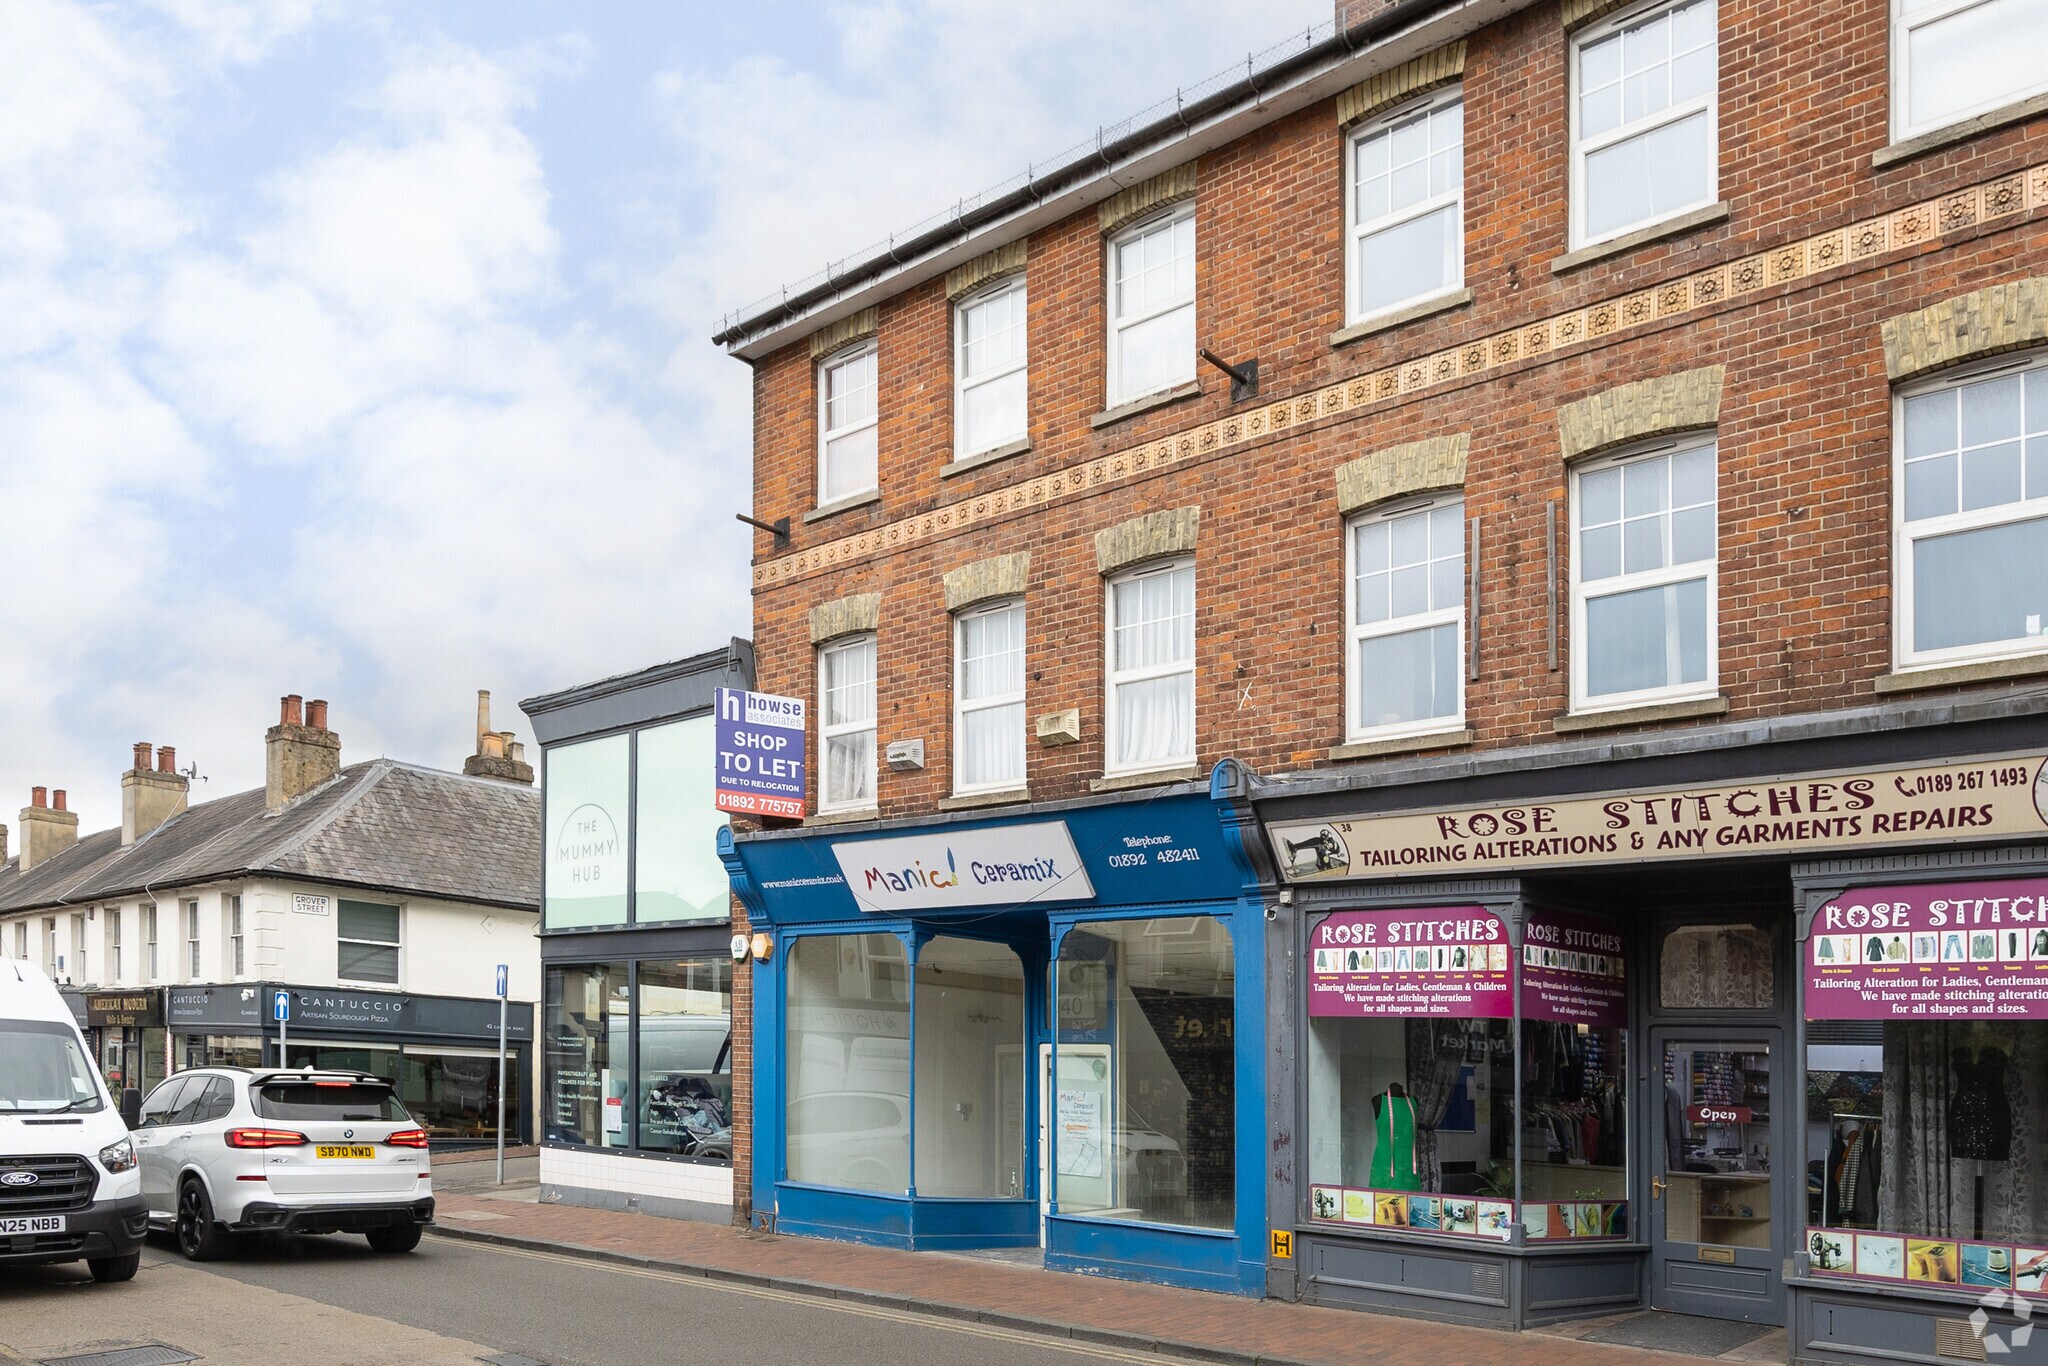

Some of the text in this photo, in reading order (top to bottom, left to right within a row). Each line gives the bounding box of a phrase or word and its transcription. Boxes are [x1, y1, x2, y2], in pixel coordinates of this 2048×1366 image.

[748, 694, 801, 716] howse
[748, 712, 802, 727] associates
[734, 731, 787, 751] SHOP
[720, 752, 800, 778] TO LET
[722, 776, 799, 792] DUE TO RELOCATION
[1917, 767, 2028, 794] 0189 267 1493
[719, 794, 801, 814] 01892 775757
[1437, 780, 1874, 839] ROSE STITCHES
[577, 820, 596, 833] THE
[1341, 823, 1352, 832] 38
[1123, 834, 1172, 849] Telephone:
[1361, 804, 1993, 866] TAILORING ALTERATIONS & ANY GARMENTS REPAIRS
[560, 839, 615, 861] MUMMY
[1109, 847, 1199, 868] 01892 482411
[573, 865, 600, 883] HUB
[971, 856, 1062, 885] Ceramix
[296, 896, 326, 905] GROVER
[297, 903, 325, 913] STREET
[1825, 902, 1911, 930] ROSE
[1322, 919, 1499, 944] ROSE STITCHES
[1528, 923, 1621, 952] ROSE STITCHES
[1314, 983, 1344, 994] Tailoring
[1346, 983, 1380, 991] Alteration
[1383, 982, 1393, 991] for
[1396, 983, 1420, 992] Ladies,
[1423, 982, 1462, 991] Gentleman
[1474, 982, 1506, 990] Children
[1524, 979, 1542, 989] Tailoring
[1543, 981, 1562, 990] Alteration
[1584, 986, 1604, 995] Gentleman
[1814, 978, 1861, 990] Tailoring
[1864, 978, 1918, 987] Alteration
[1922, 977, 1938, 987] for
[1942, 977, 1981, 987] Ladies,
[1344, 993, 1471, 1004] We have made stitching alterations
[1571, 996, 1587, 1006] stitching
[1861, 991, 1878, 1000] We
[1882, 991, 1907, 1000] have
[1911, 990, 1940, 1000] made
[1945, 990, 1994, 1002] stitching
[301, 997, 402, 1012] CANTUCCIO
[1061, 997, 1082, 1015] 40
[1364, 1004, 1449, 1014] for all shapes and sizes.
[1566, 1007, 1579, 1015] shapes
[1892, 1004, 2028, 1016] for all shapes and sizes.
[1701, 1108, 1736, 1121] Open
[320, 1146, 372, 1157] SB70 NWD
[6, 1172, 33, 1185] Ford
[32, 1218, 60, 1230] NBB
